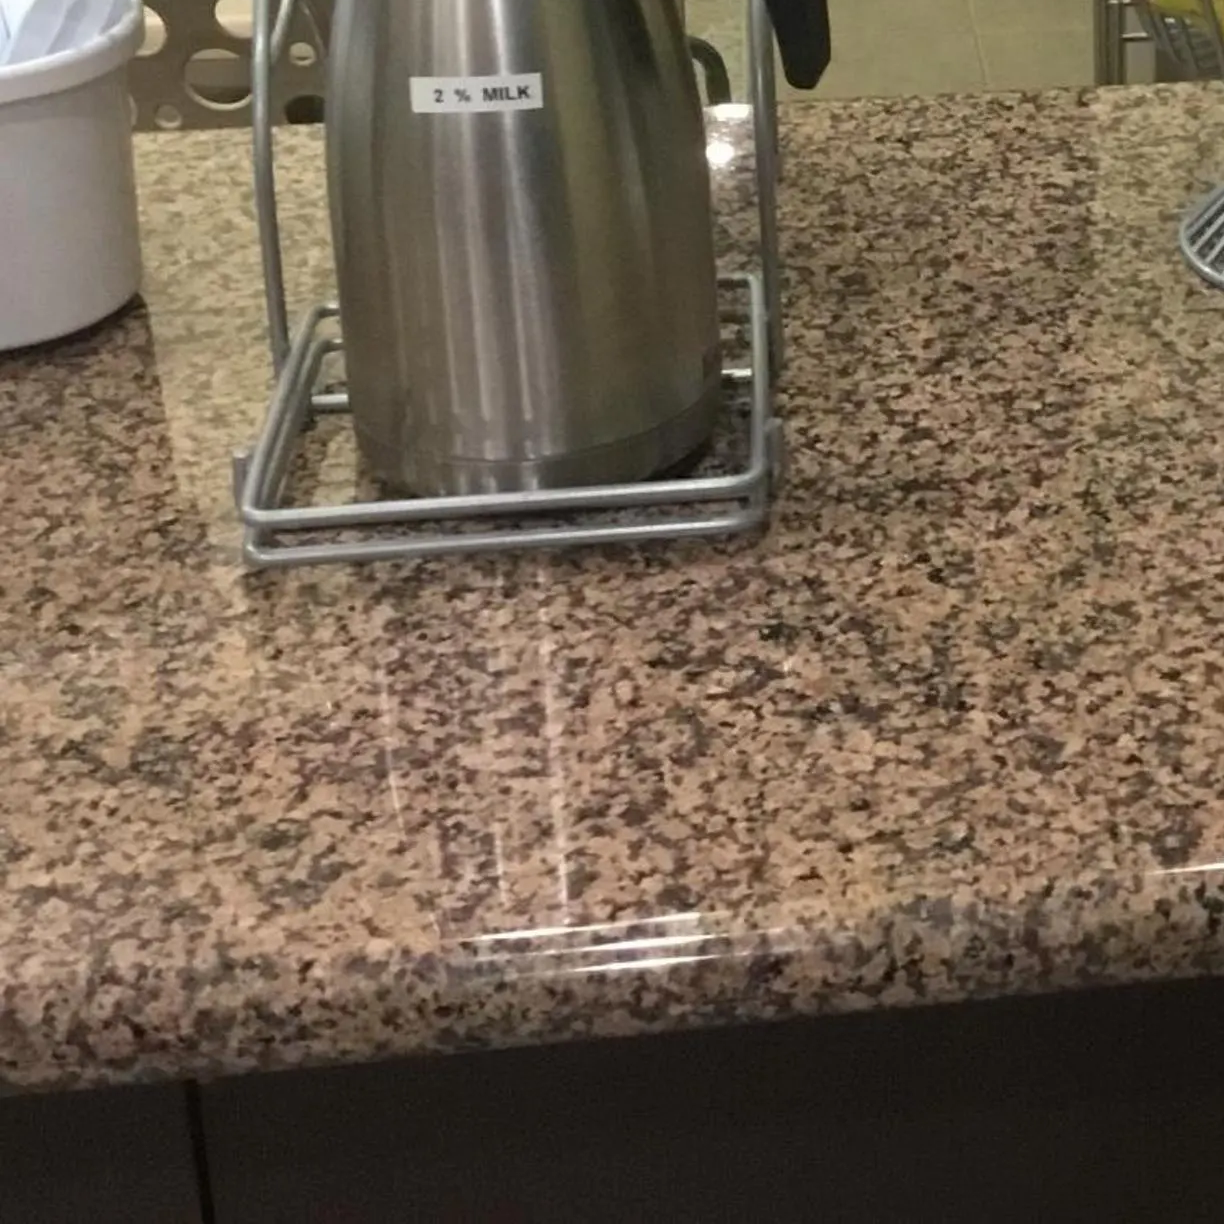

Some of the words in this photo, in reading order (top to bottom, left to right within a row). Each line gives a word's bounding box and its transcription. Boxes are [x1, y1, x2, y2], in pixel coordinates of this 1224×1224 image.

[433, 88, 444, 103] 2
[453, 88, 471, 103] %
[482, 86, 531, 102] MILK
